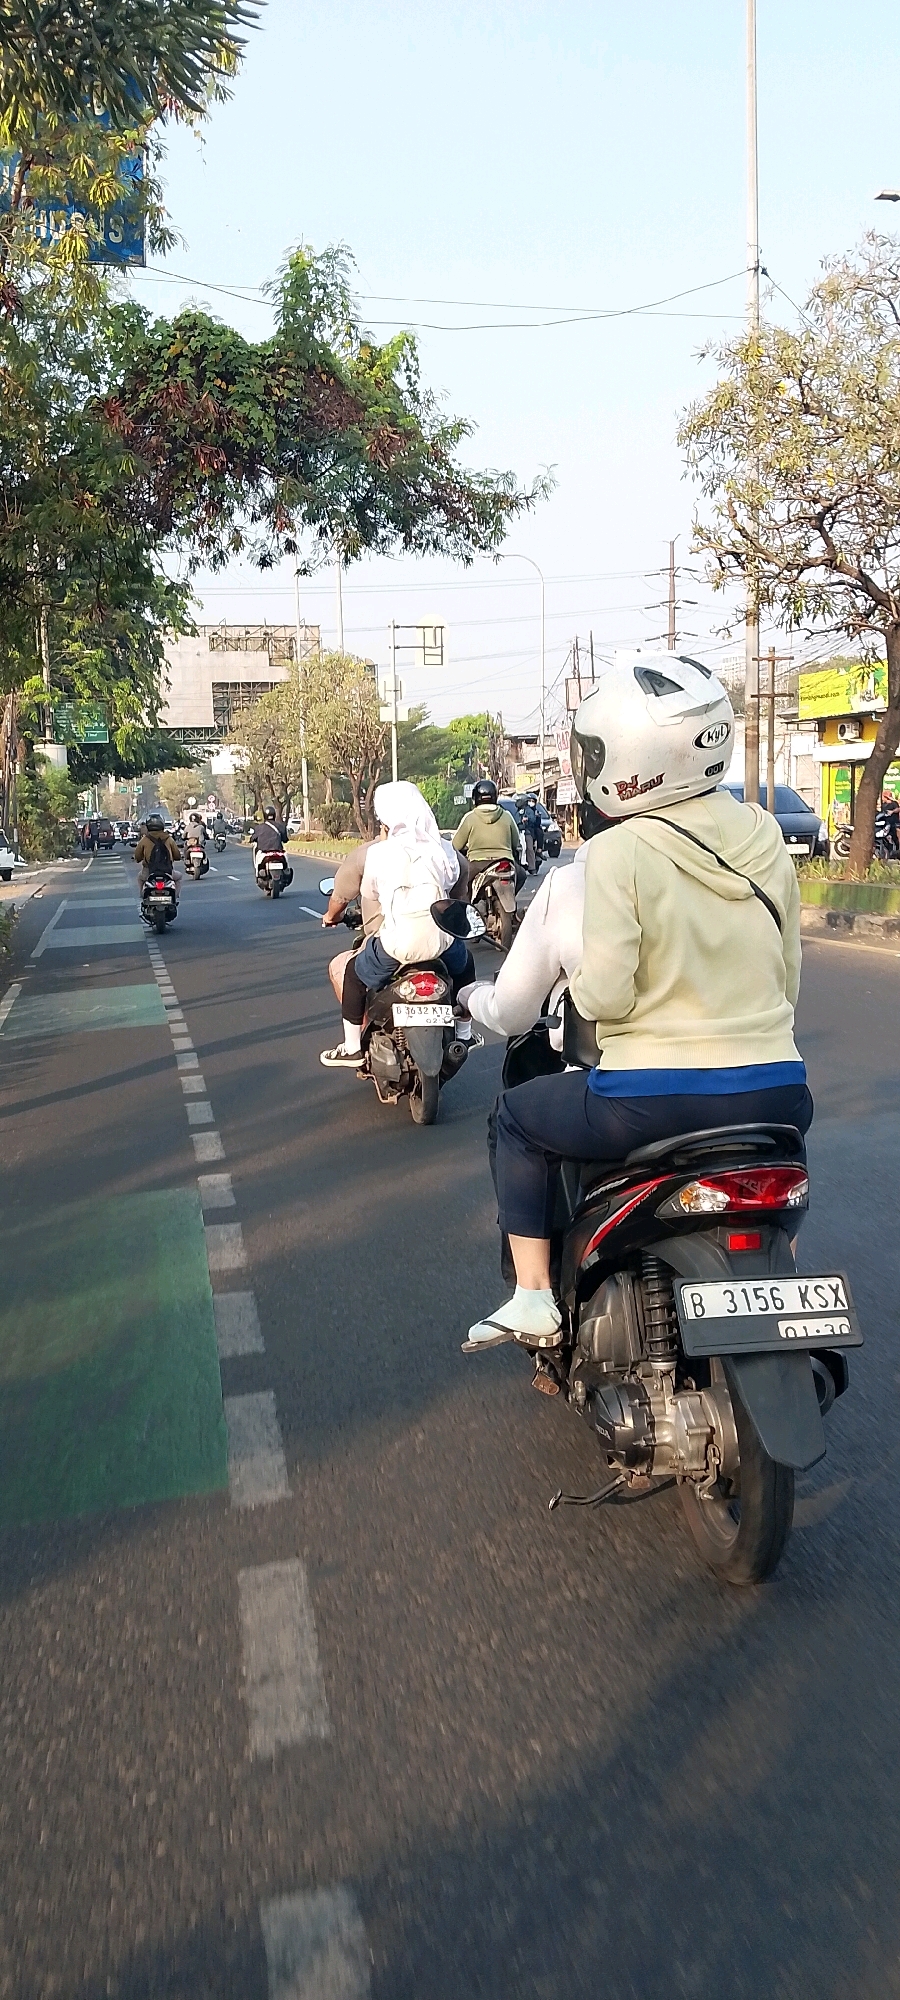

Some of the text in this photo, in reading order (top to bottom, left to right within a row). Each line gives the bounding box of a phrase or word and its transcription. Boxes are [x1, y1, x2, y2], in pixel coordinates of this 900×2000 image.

[707, 763, 723, 776] DOT
[613, 774, 639, 791] DJ
[617, 772, 665, 801] MARU
[690, 1283, 846, 1318] B 3156 KSX
